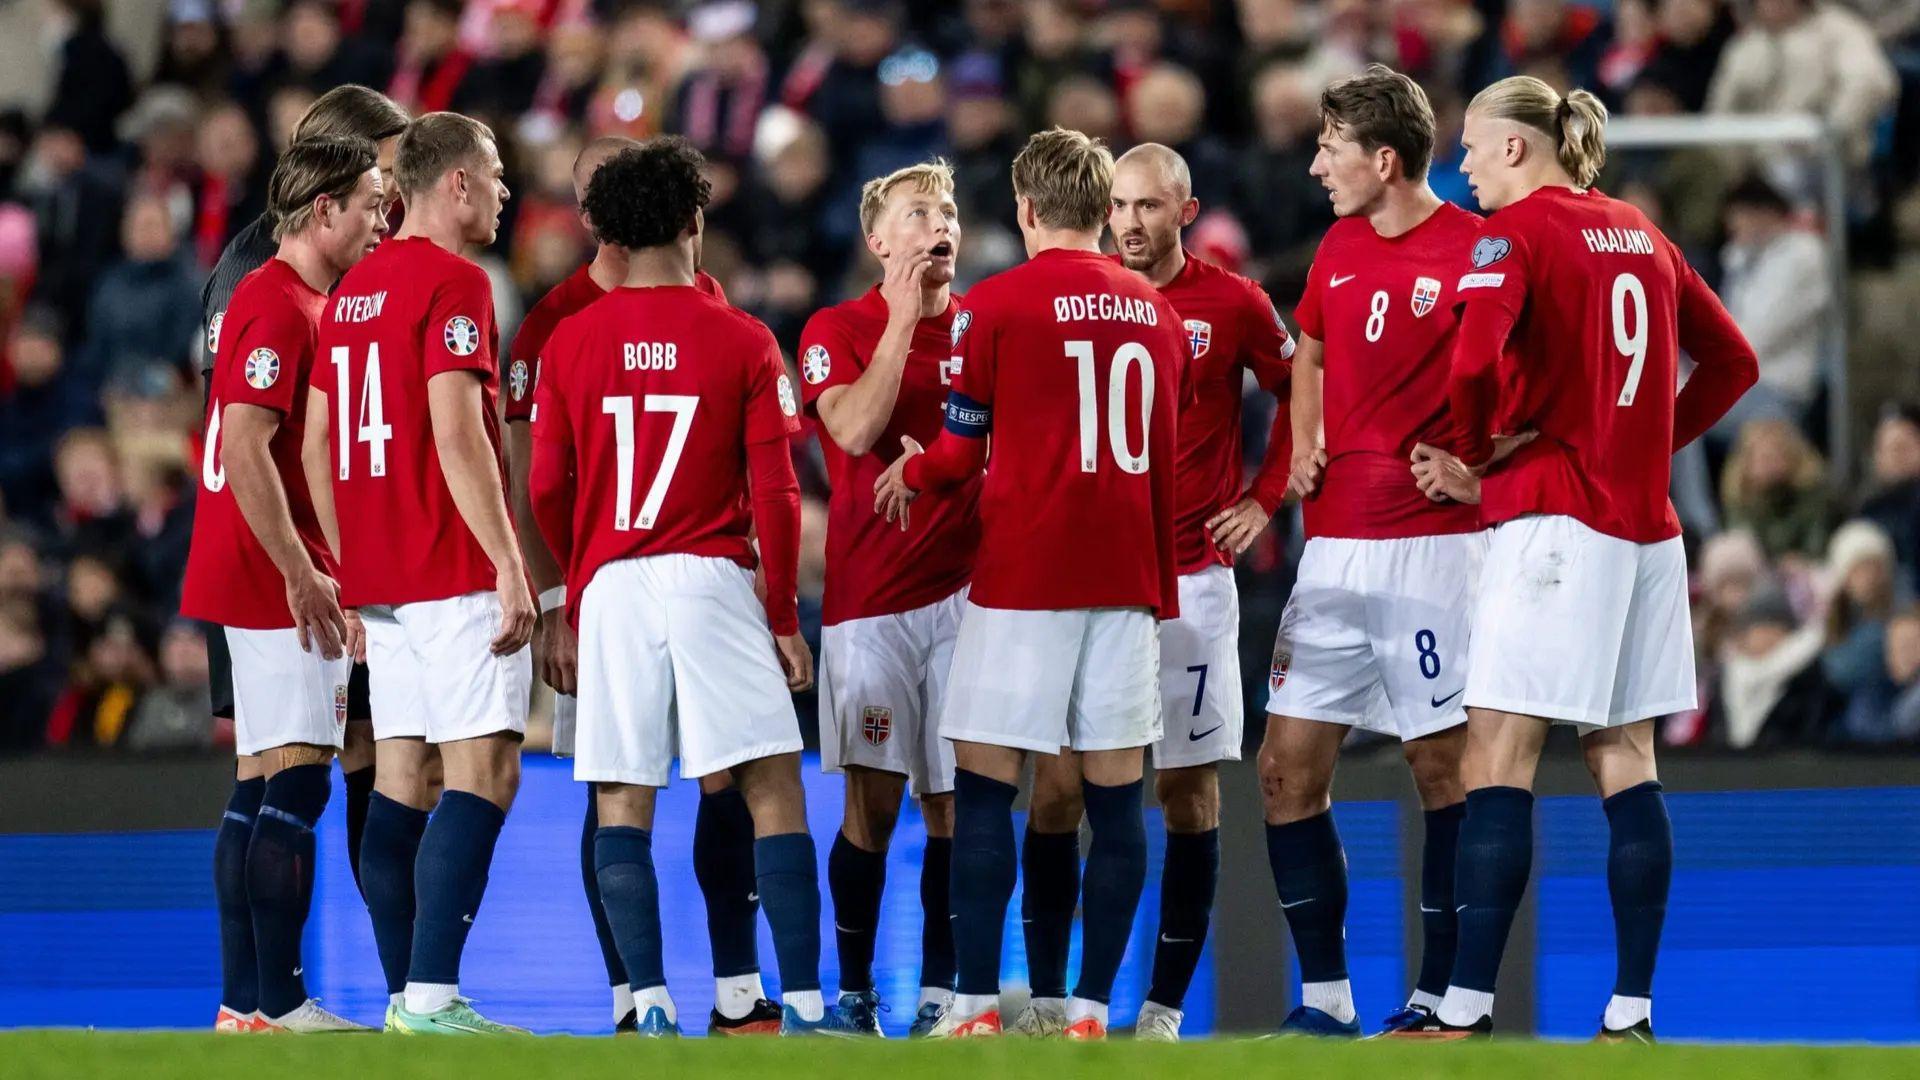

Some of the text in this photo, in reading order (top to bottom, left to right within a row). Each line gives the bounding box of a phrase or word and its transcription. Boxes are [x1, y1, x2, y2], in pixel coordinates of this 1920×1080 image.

[1581, 228, 1654, 254] HAALAND
[1053, 293, 1158, 326] ØDEGAARD
[1365, 291, 1389, 342] 8
[623, 342, 677, 371] BOBB
[1611, 273, 1648, 406] 9
[331, 342, 393, 481] 14
[1064, 340, 1155, 475] 10
[602, 394, 700, 532] 17
[1414, 629, 1441, 679] 8
[1187, 664, 1208, 716] 7
